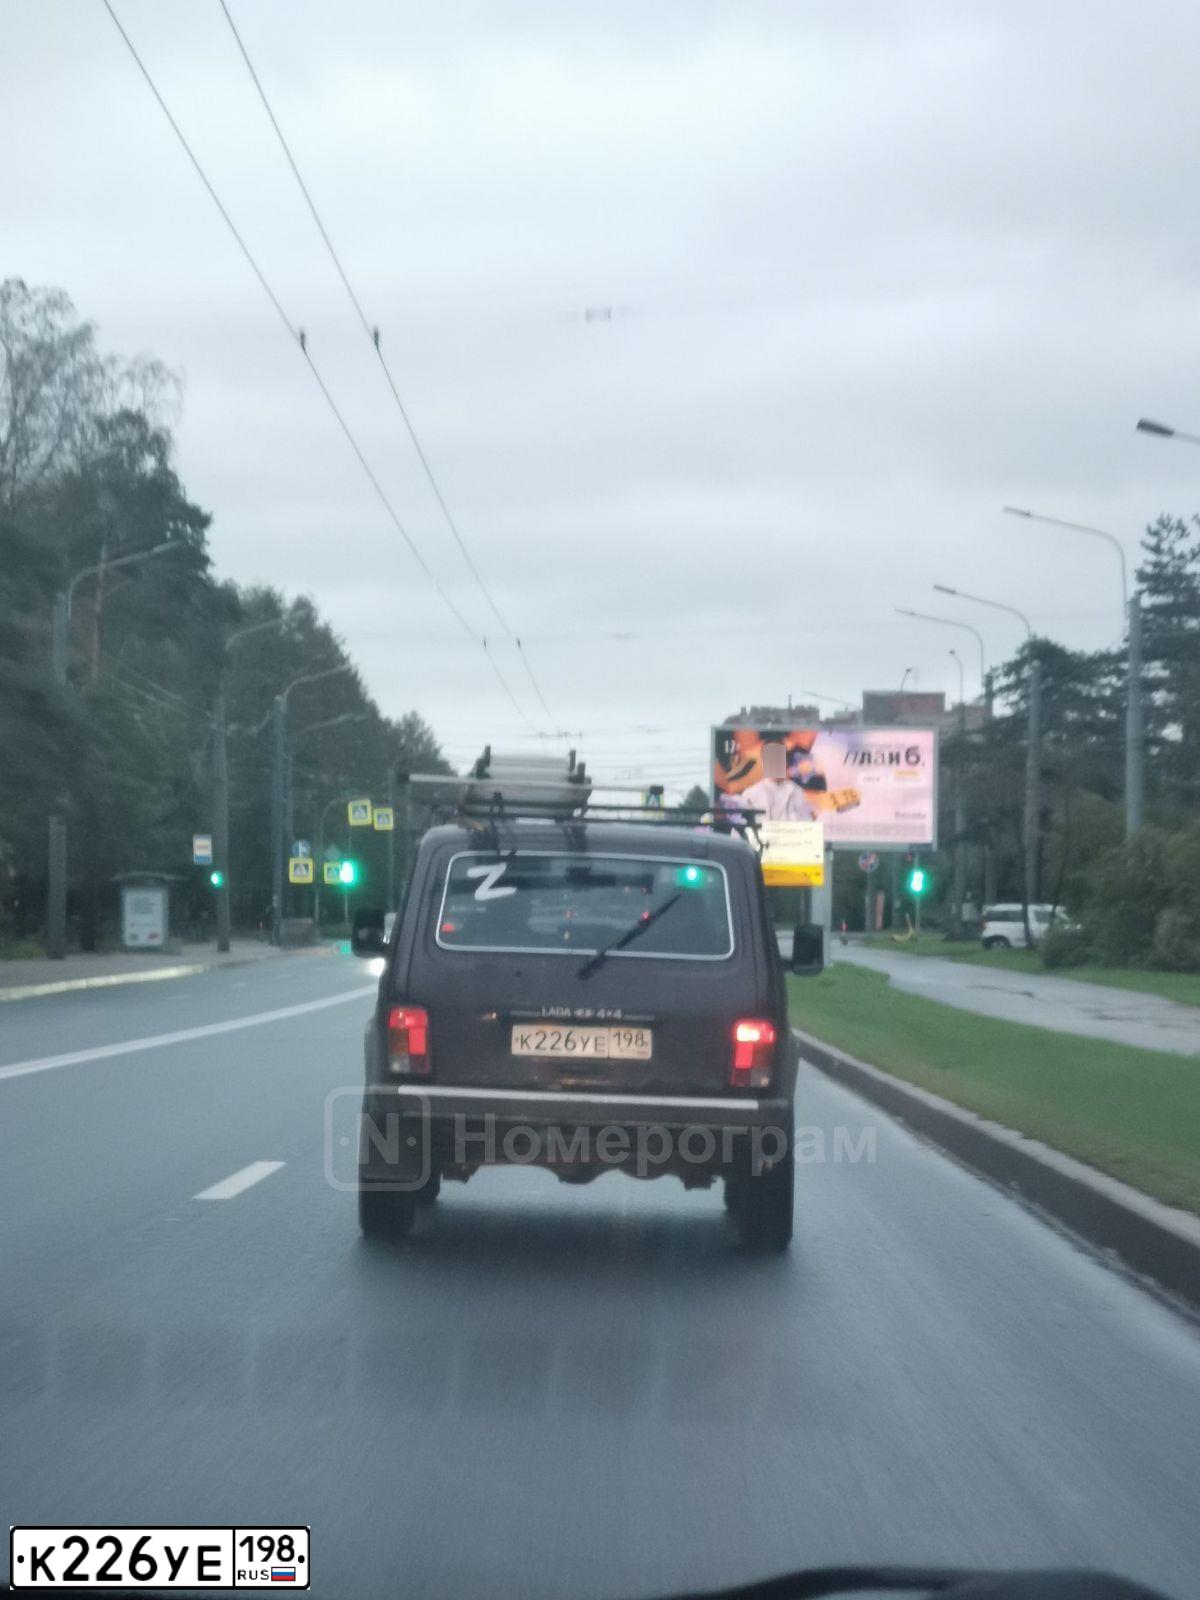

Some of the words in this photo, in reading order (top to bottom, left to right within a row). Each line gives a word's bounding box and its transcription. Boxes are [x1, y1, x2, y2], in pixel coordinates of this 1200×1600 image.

[466, 862, 518, 901] Z
[541, 1006, 571, 1017] LADA
[612, 1031, 645, 1048] 198
